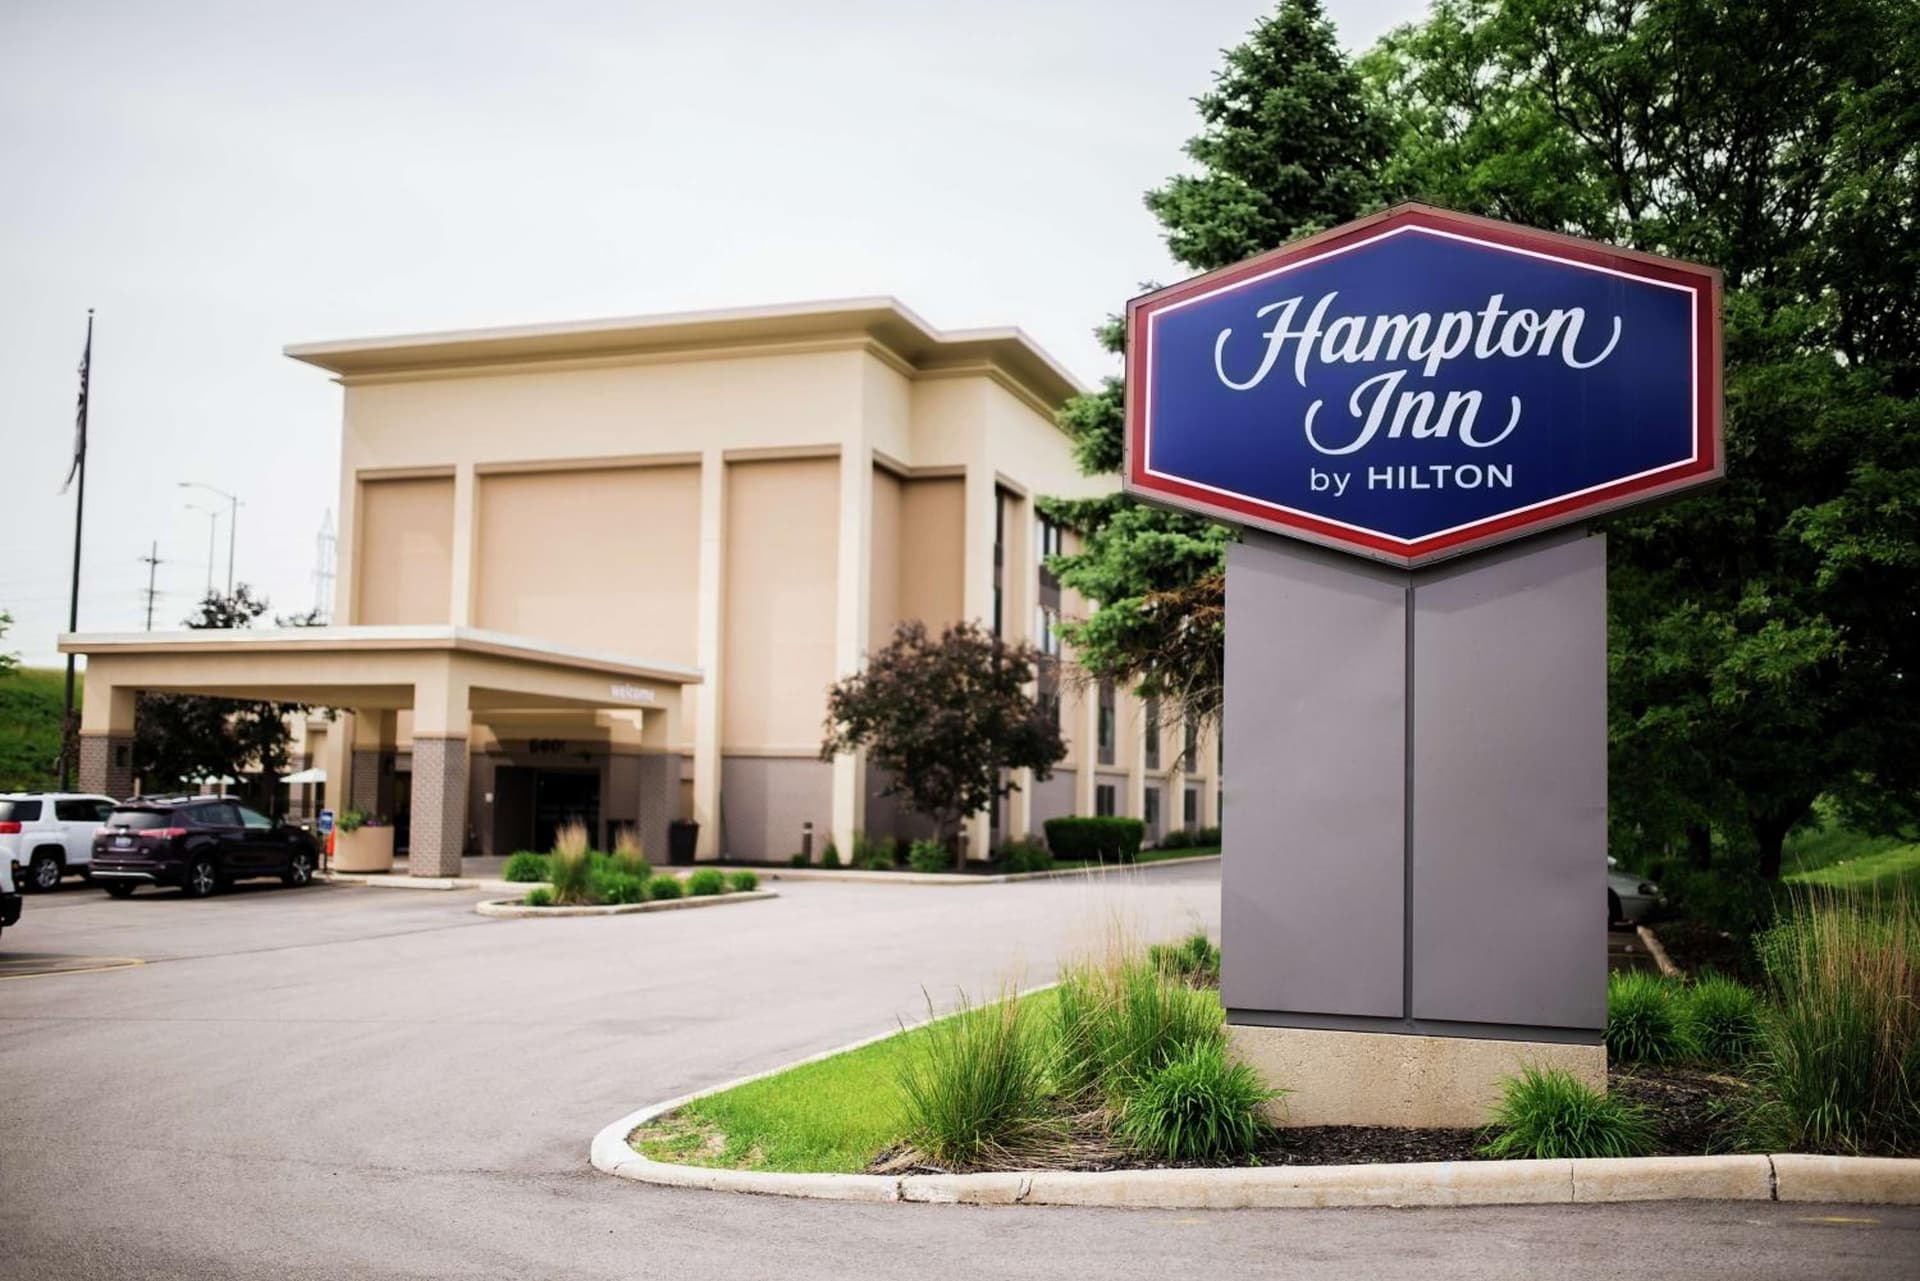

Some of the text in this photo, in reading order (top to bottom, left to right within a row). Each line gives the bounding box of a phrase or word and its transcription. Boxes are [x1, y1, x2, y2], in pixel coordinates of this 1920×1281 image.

[1215, 291, 1622, 391] Hampton
[1305, 370, 1521, 455] Inn
[1311, 464, 1514, 497] by HILTON
